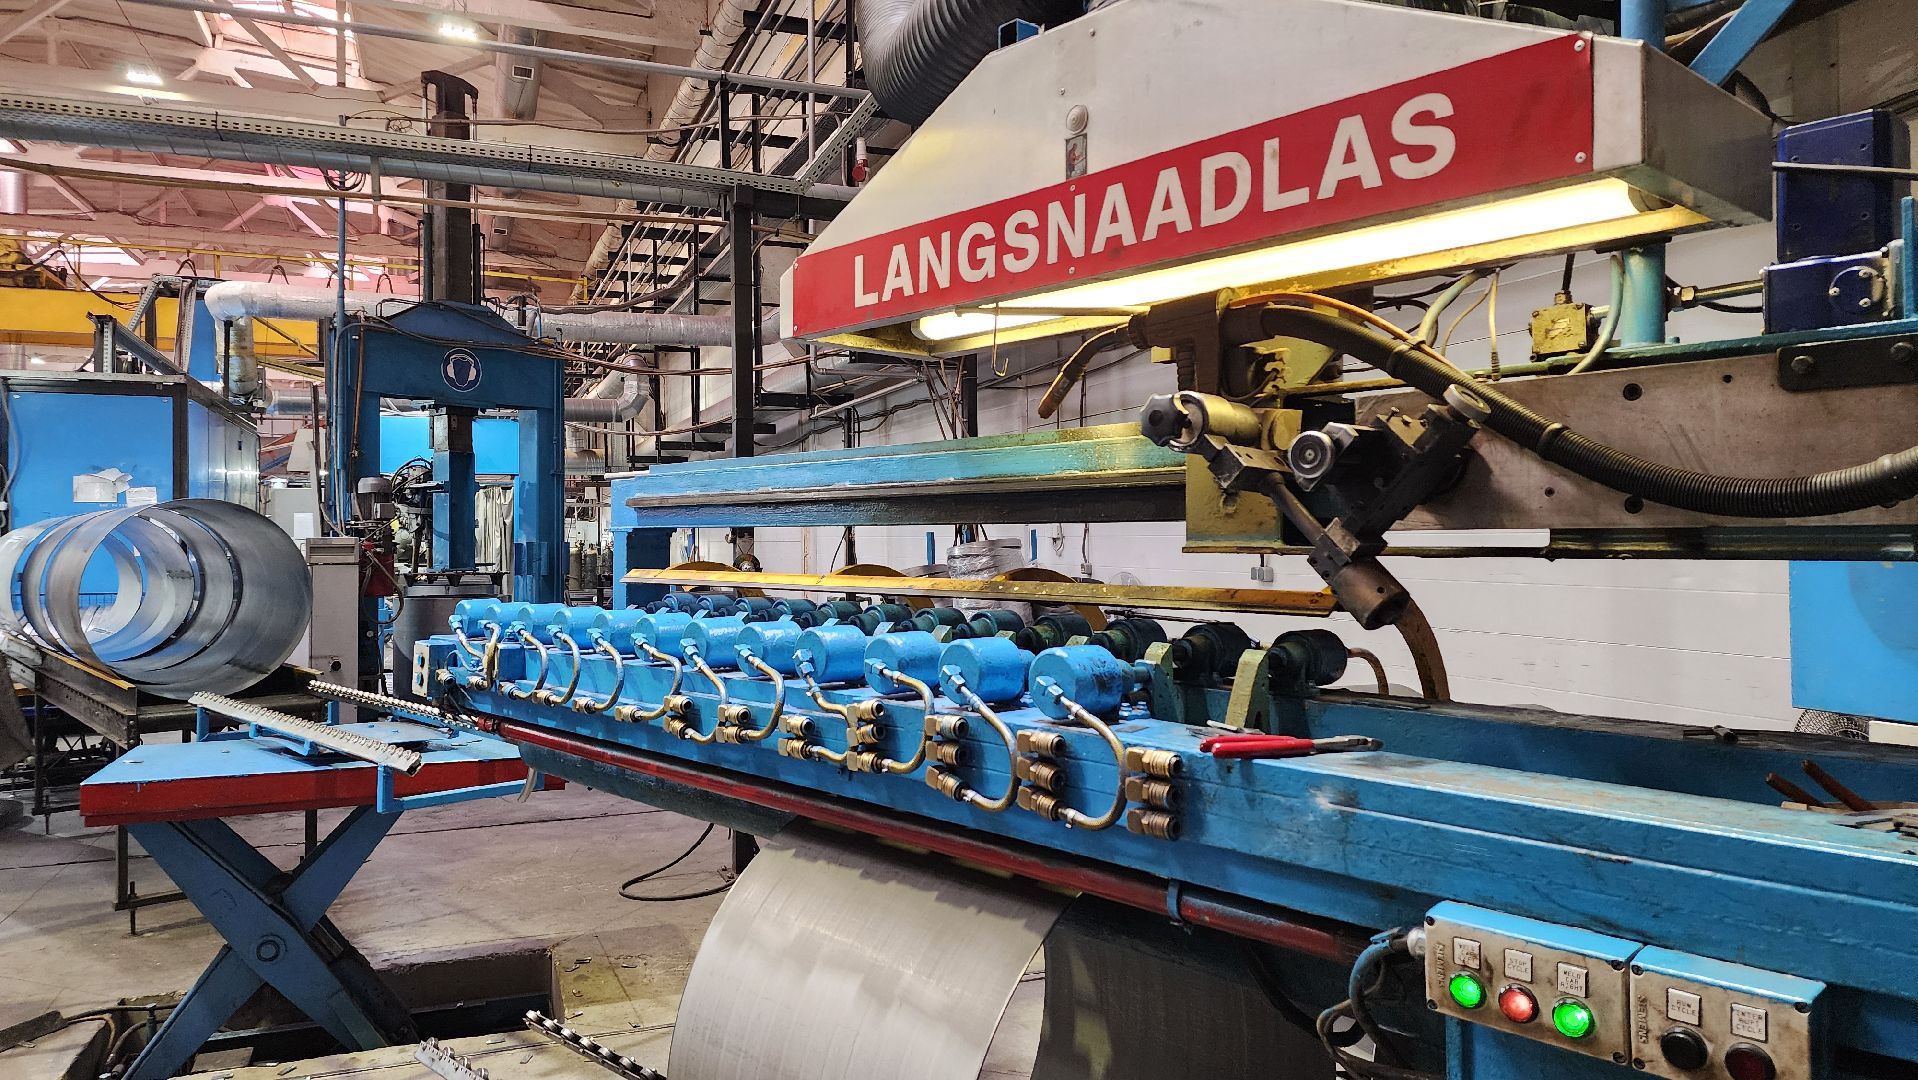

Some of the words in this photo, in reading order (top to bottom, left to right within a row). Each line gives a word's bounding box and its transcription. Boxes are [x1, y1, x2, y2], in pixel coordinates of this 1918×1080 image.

[854, 93, 1456, 308] LANGSNAADLAS
[1560, 981, 1583, 992] RIGHT
[1671, 1004, 1697, 1016] CYCLE
[1676, 999, 1692, 1009] RUN
[1637, 994, 1649, 1044] SIEMENS
